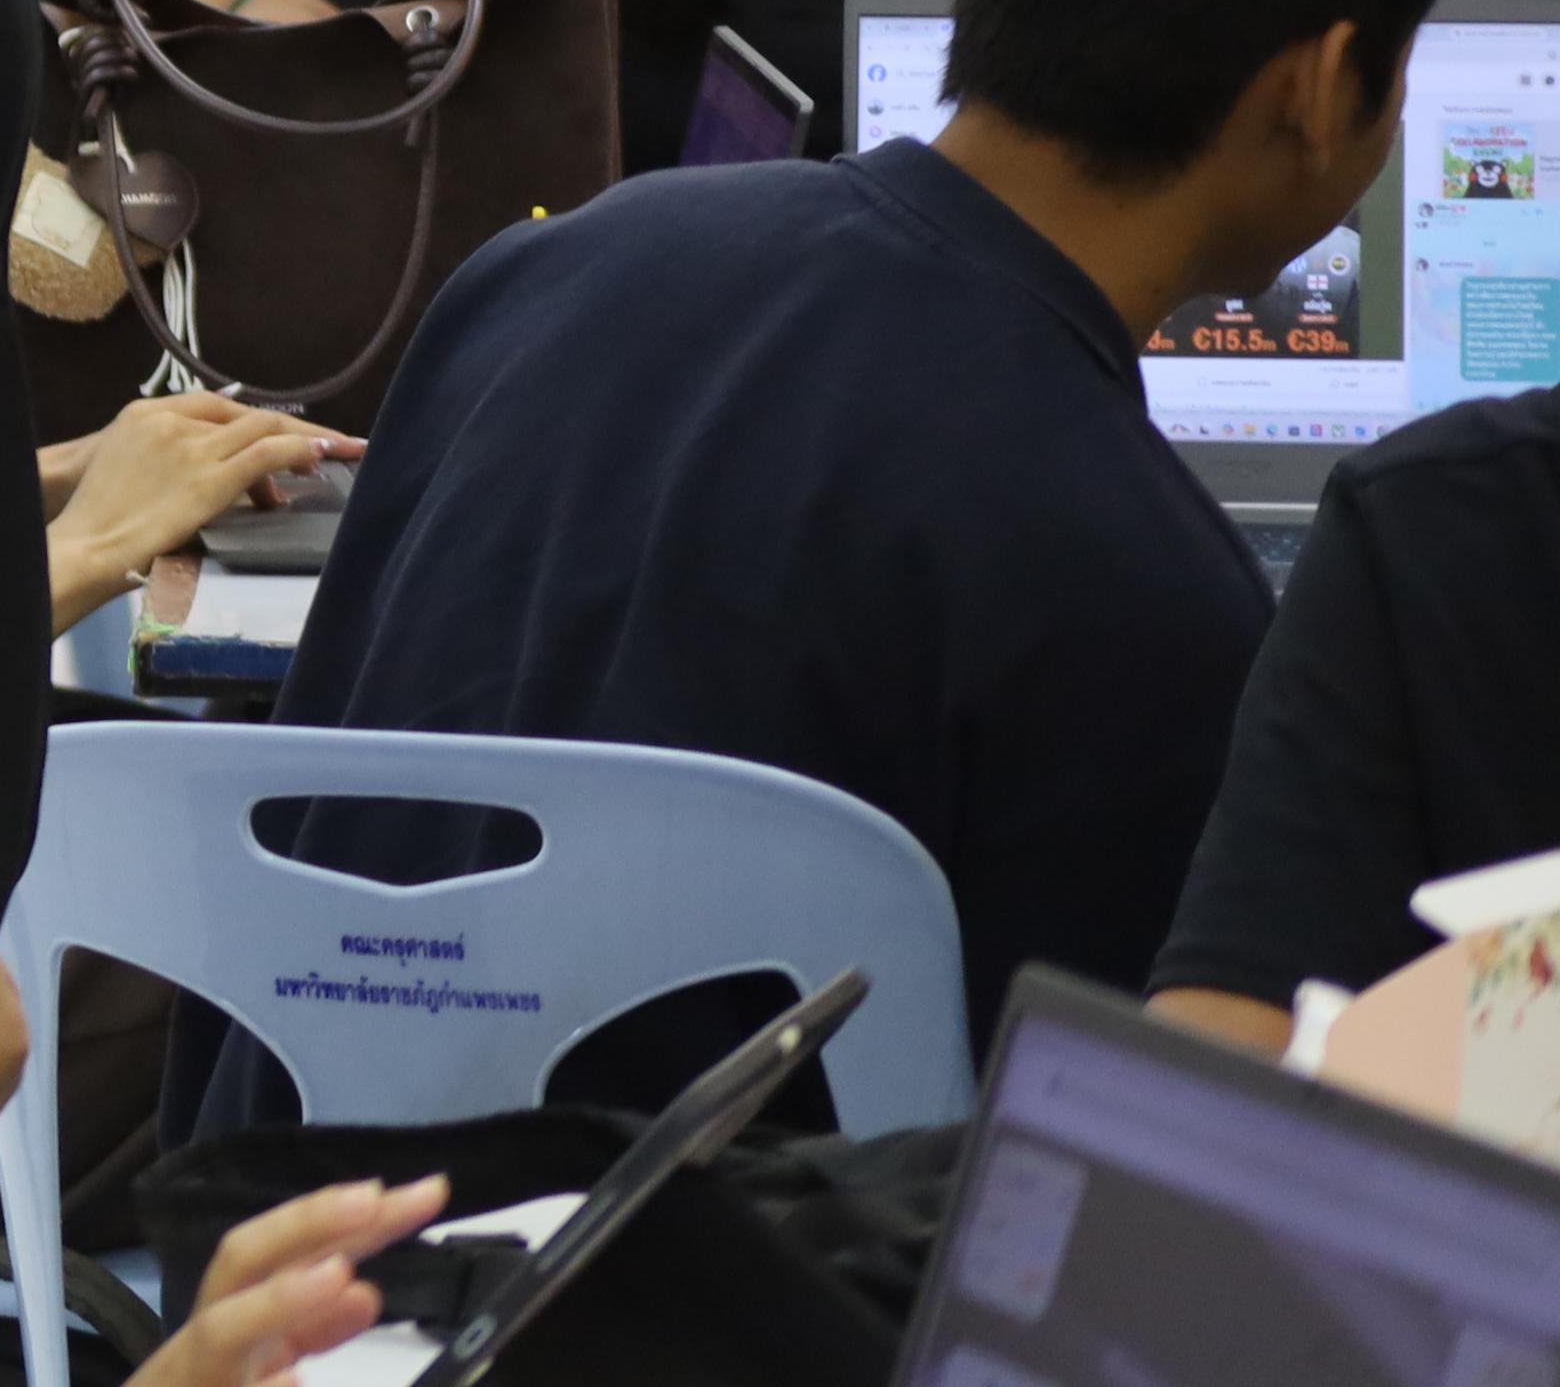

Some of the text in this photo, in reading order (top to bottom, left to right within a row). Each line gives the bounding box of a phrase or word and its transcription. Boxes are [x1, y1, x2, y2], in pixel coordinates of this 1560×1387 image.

[1192, 327, 1277, 351] €15.5m
[1287, 328, 1350, 352] €39m
[341, 932, 465, 968] คณะครุศาสตร์
